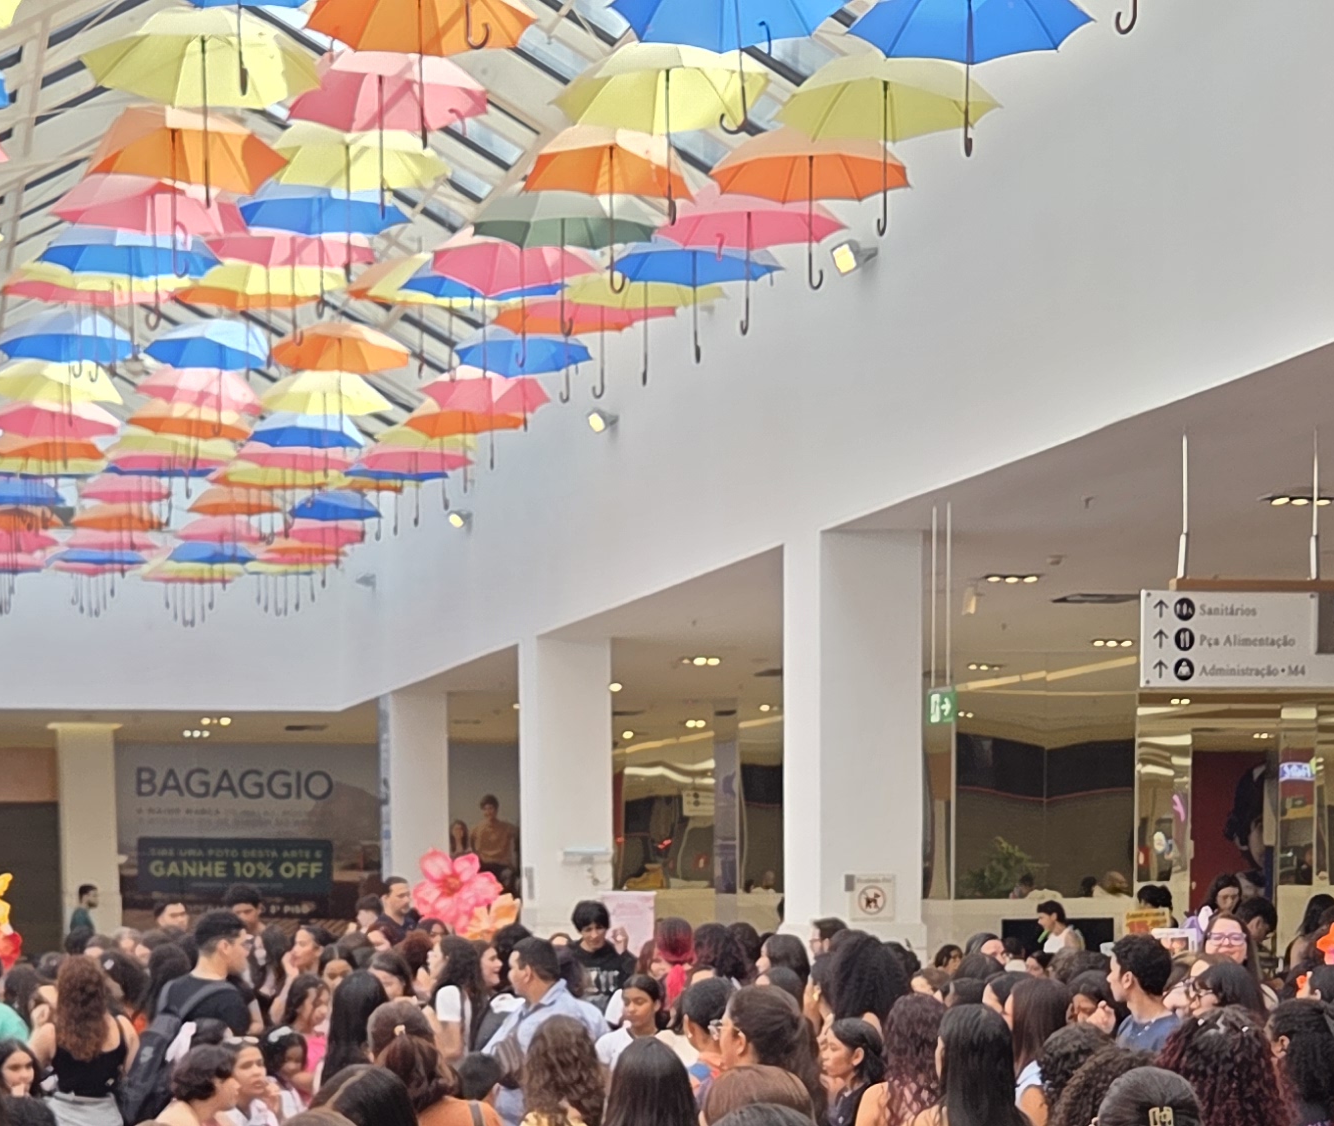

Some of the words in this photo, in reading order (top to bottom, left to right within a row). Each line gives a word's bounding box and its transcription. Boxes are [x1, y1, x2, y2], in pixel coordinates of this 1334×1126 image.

[1199, 600, 1257, 616] Sanitários
[1224, 634, 1296, 649] Alimentação
[1199, 664, 1279, 679] Administração
[1287, 665, 1306, 676] M4
[135, 766, 334, 800] BAGAGGIO
[149, 860, 227, 879] GANHE
[233, 860, 274, 880] 10%
[279, 862, 324, 880] OFF
